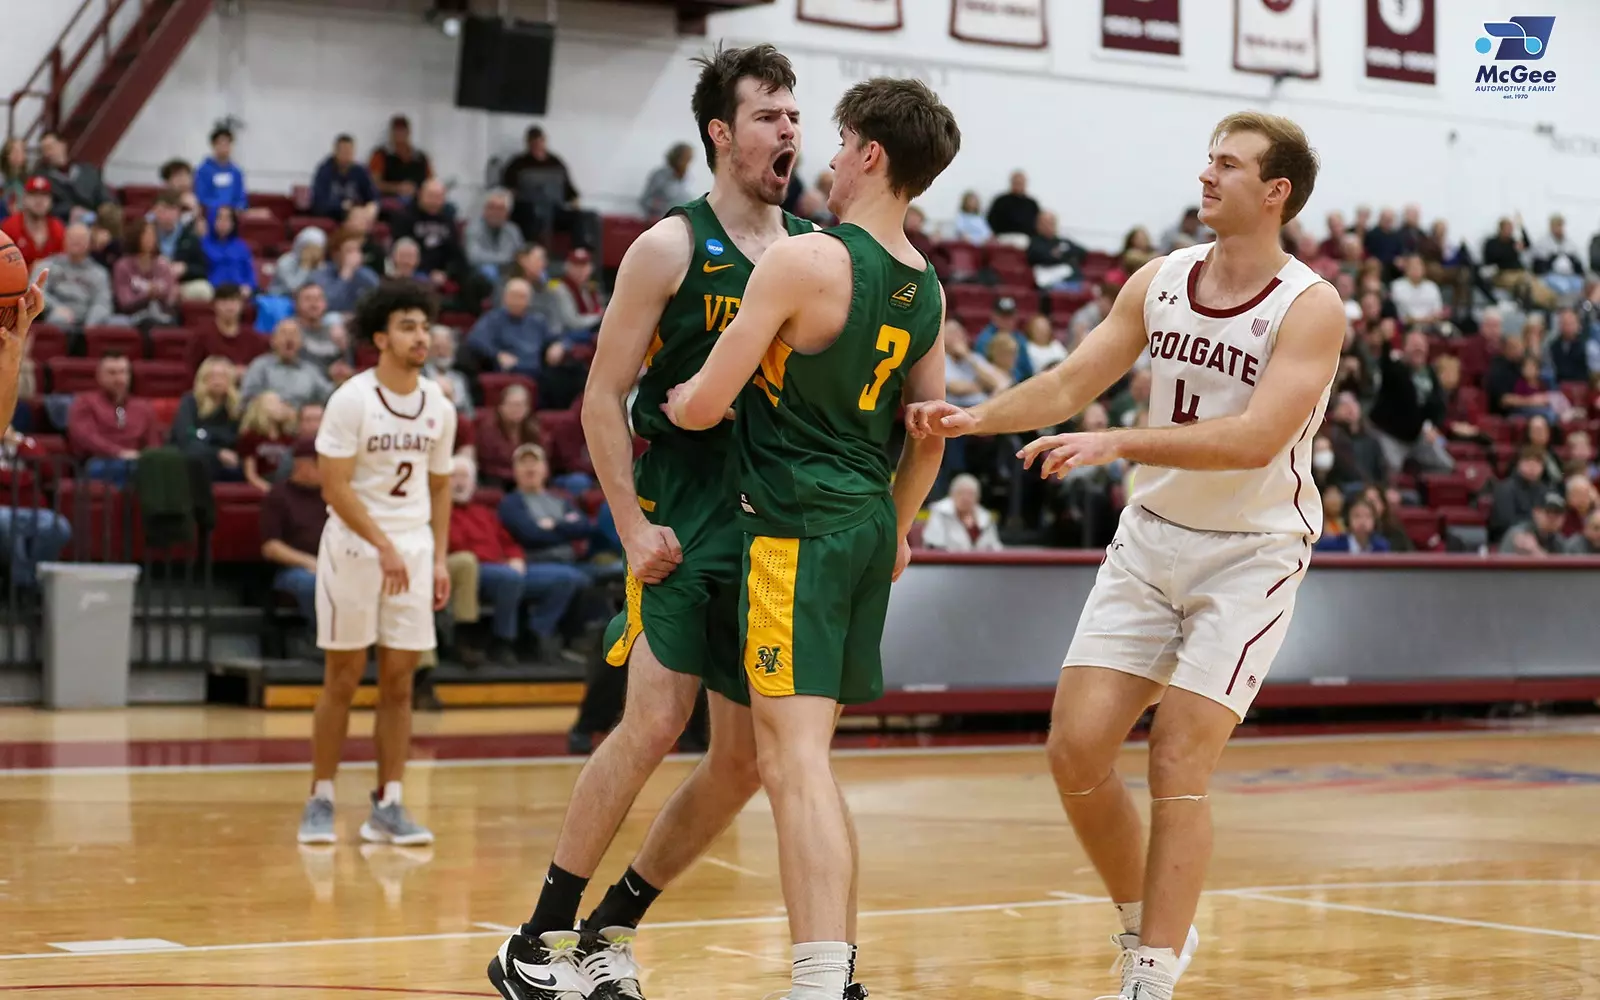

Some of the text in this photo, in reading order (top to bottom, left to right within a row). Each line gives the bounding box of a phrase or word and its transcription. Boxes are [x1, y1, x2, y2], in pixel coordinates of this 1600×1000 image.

[858, 324, 911, 411] 3
[1150, 331, 1259, 387] COLGATE
[1171, 379, 1201, 424] 4
[389, 461, 413, 497] 2
